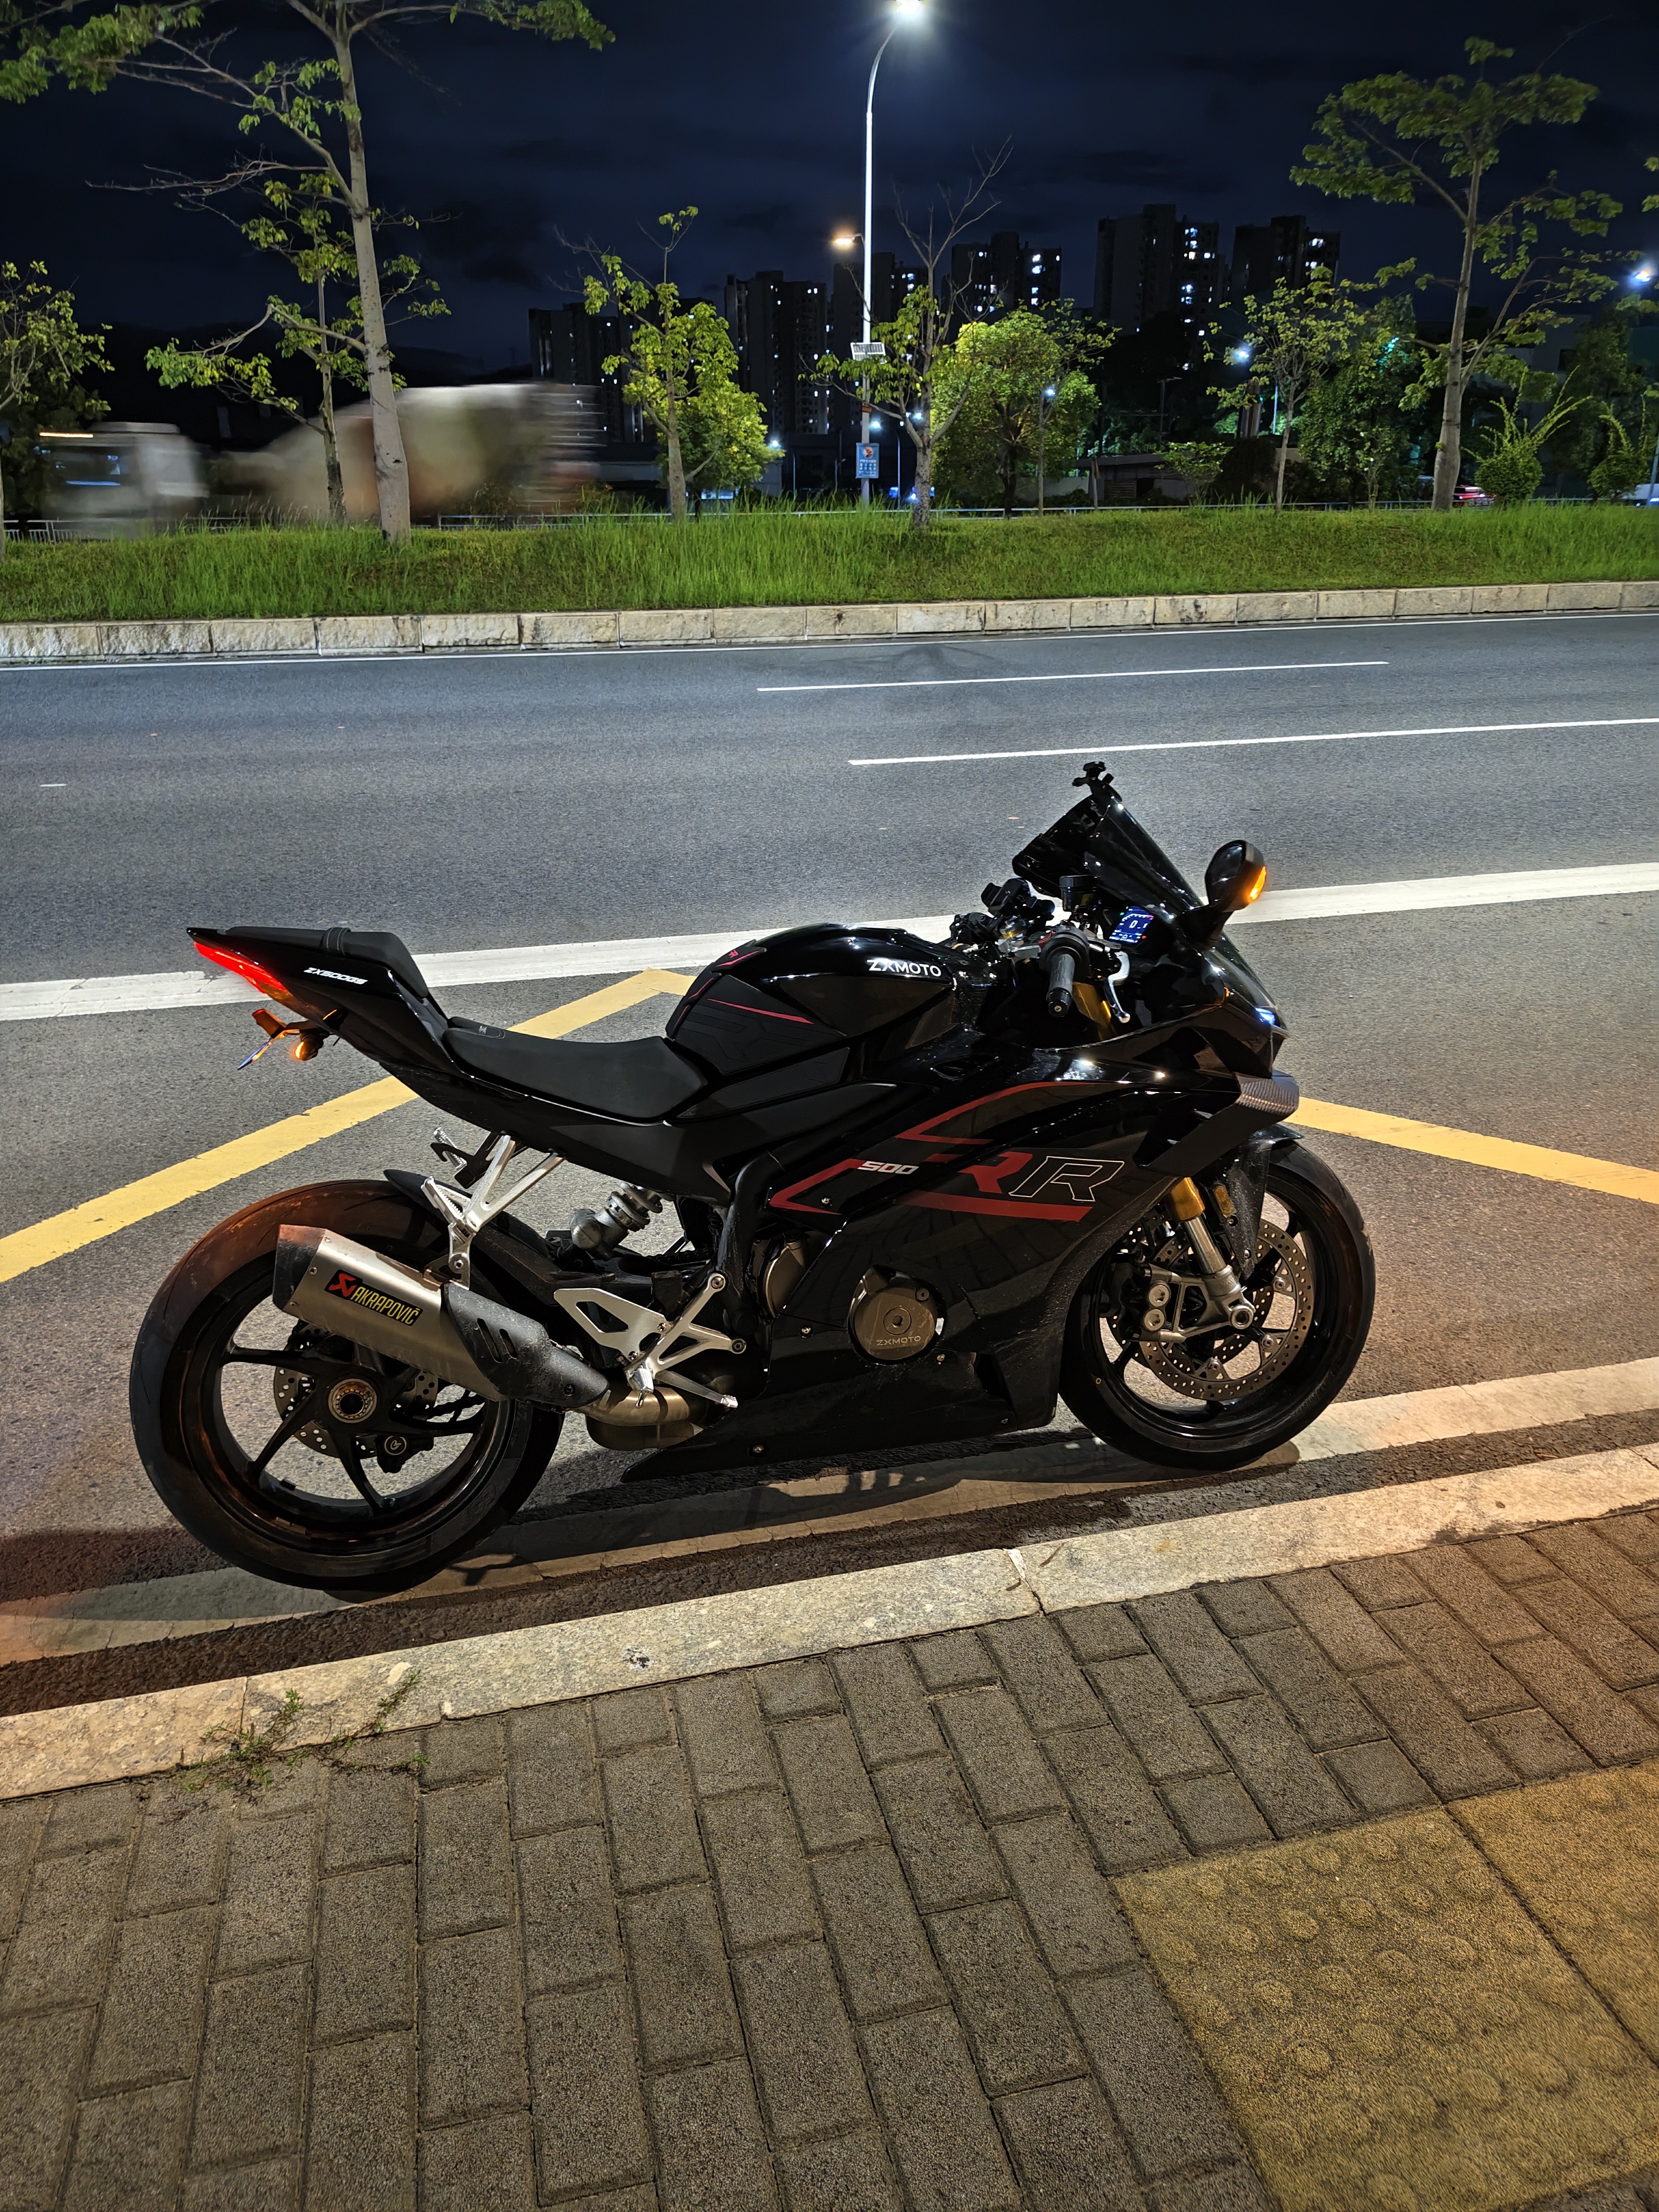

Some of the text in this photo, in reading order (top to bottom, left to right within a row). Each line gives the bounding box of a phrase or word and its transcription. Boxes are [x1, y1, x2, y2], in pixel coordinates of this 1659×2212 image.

[867, 959, 941, 977] ZXMOTO
[857, 1161, 919, 1175] 500
[876, 1336, 921, 1346] ZXMOTO
